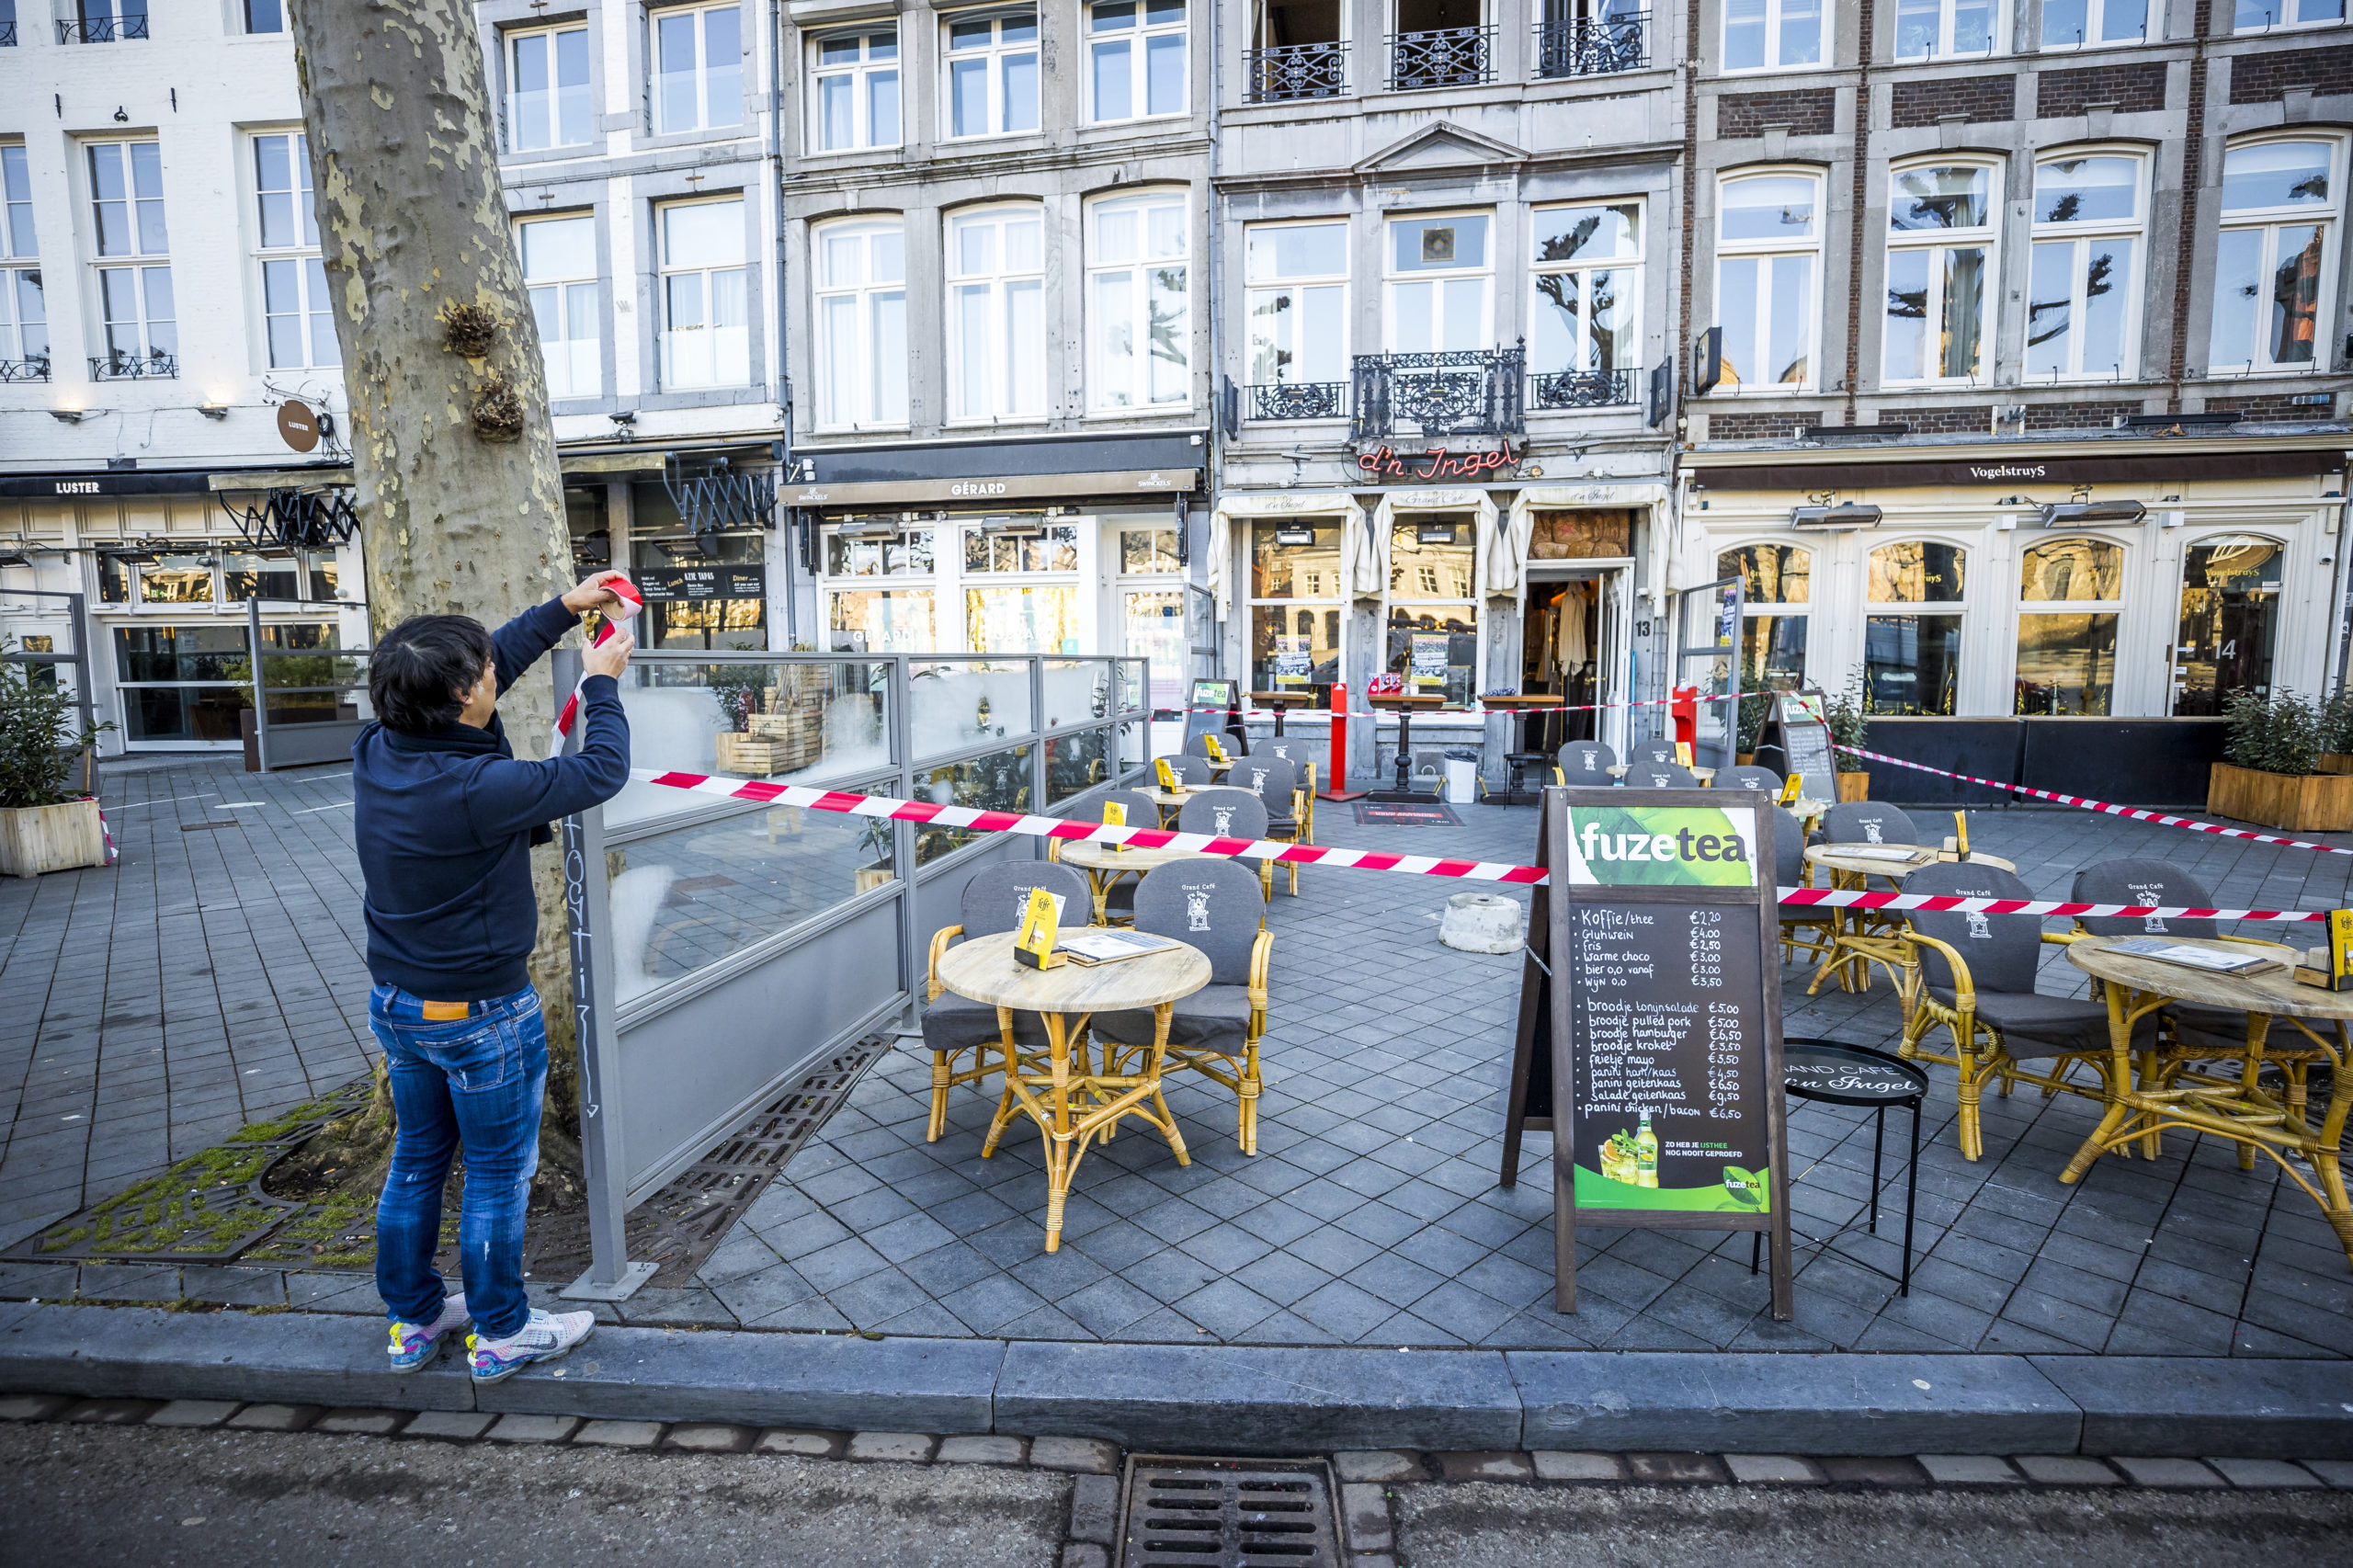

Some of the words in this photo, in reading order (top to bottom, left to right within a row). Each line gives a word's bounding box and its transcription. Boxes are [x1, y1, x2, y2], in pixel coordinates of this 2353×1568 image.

[288, 421, 309, 432] LUSTER
[1359, 446, 1404, 476] d'n
[1970, 465, 2045, 480] VogelstruyS
[55, 482, 100, 494] LUSTER
[950, 481, 1006, 496] GÉRARD
[666, 577, 684, 587] Lunch
[698, 572, 715, 580] TAPAS
[1636, 620, 1651, 637] 13
[2215, 639, 2236, 660] 14
[1580, 822, 1748, 862] fuzetea
[1621, 950, 1651, 961] choco
[1586, 963, 1605, 975] bier
[1628, 963, 1654, 979] vanaf
[1586, 996, 1633, 1017] broodje
[1588, 1014, 1630, 1032] broodje
[1632, 1015, 1665, 1028] pulled
[1667, 1017, 1692, 1030] pork
[1589, 1028, 1629, 1042] broodje
[1632, 1026, 1688, 1046] hamburger
[1590, 1040, 1633, 1055] broodje
[1636, 1040, 1673, 1051] kroket
[1627, 1056, 1655, 1071] mayo
[1784, 1064, 1836, 1074] AND
[1590, 1066, 1621, 1081] panini
[1591, 1079, 1623, 1095] panini
[1626, 1078, 1682, 1094] geitenkaas
[1827, 1075, 1918, 1093] Ingel
[1631, 1090, 1687, 1105] geitenkaas
[1584, 1103, 1621, 1119] panini
[1709, 1107, 1742, 1119] €6,50
[1699, 1142, 1728, 1150] IJSTHEE
[1705, 1150, 1743, 1158] GEPROEFD
[1725, 1178, 1760, 1188] fuzetea
